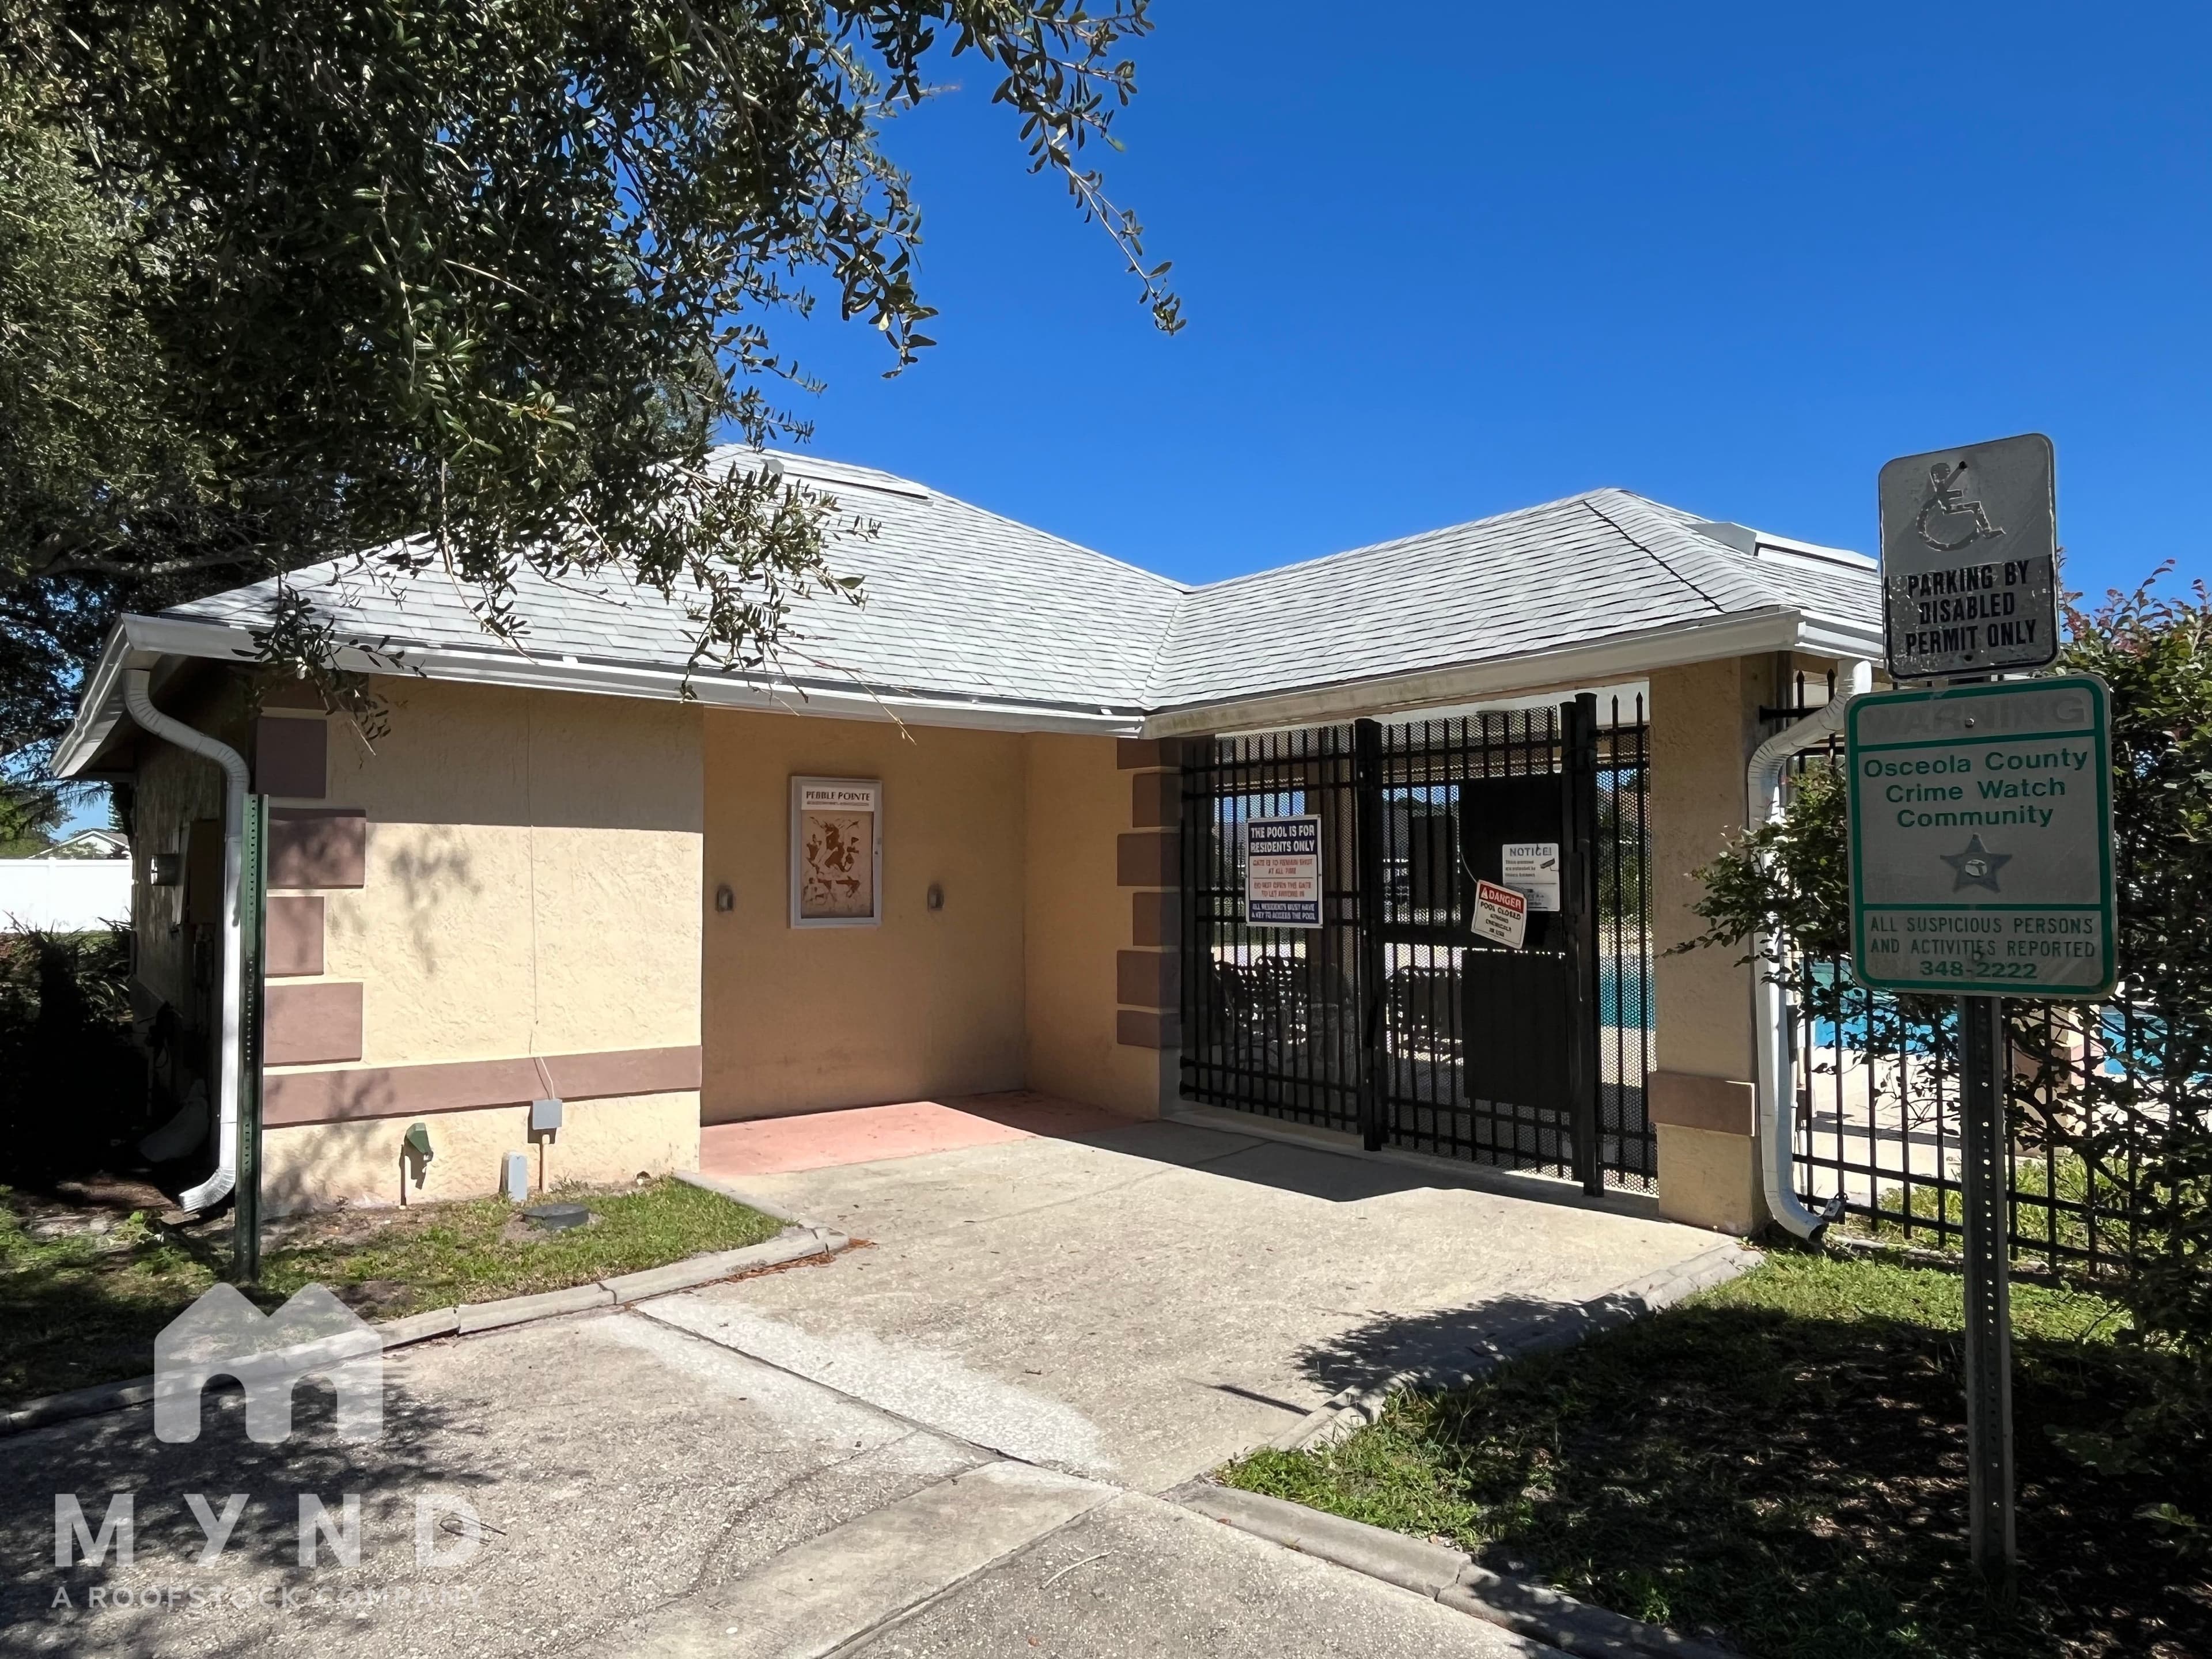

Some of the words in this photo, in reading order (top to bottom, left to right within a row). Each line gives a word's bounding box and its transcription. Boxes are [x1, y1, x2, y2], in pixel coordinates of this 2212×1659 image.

[1908, 565, 1994, 597] PARKING
[2005, 560, 2030, 586] BY
[1919, 592, 2016, 625] DISABLED
[1906, 625, 1979, 657] PERMIT
[1987, 619, 2037, 648] ONLY
[1862, 695, 2085, 737] WARNING
[1864, 755, 1972, 778] Osceola
[1985, 748, 2088, 771] County
[806, 791, 835, 800] PEBBLE
[838, 793, 870, 801] POINTE
[1885, 783, 1964, 803] Crime
[1977, 777, 2066, 800] Watch
[1897, 805, 2054, 828] Community
[1251, 827, 1264, 838] THE
[1267, 826, 1287, 838] POOL
[1289, 825, 1296, 836] IS
[1299, 825, 1315, 836] FOR
[1251, 841, 1291, 853] RESIDENTS
[1293, 840, 1315, 851] ONLY
[1488, 890, 1521, 910] DANGER
[1480, 901, 1495, 912] POOL
[1498, 907, 1521, 920] CLOSED
[1870, 917, 1897, 933] ALL
[1907, 917, 2002, 934] SUSPICIOUS
[2014, 917, 2093, 934] PERSONS
[1870, 939, 1900, 954] AND
[1910, 939, 1996, 956] ACTIVITIES
[2008, 940, 2096, 959] REPORTED
[1920, 961, 2038, 979] 348-2222
